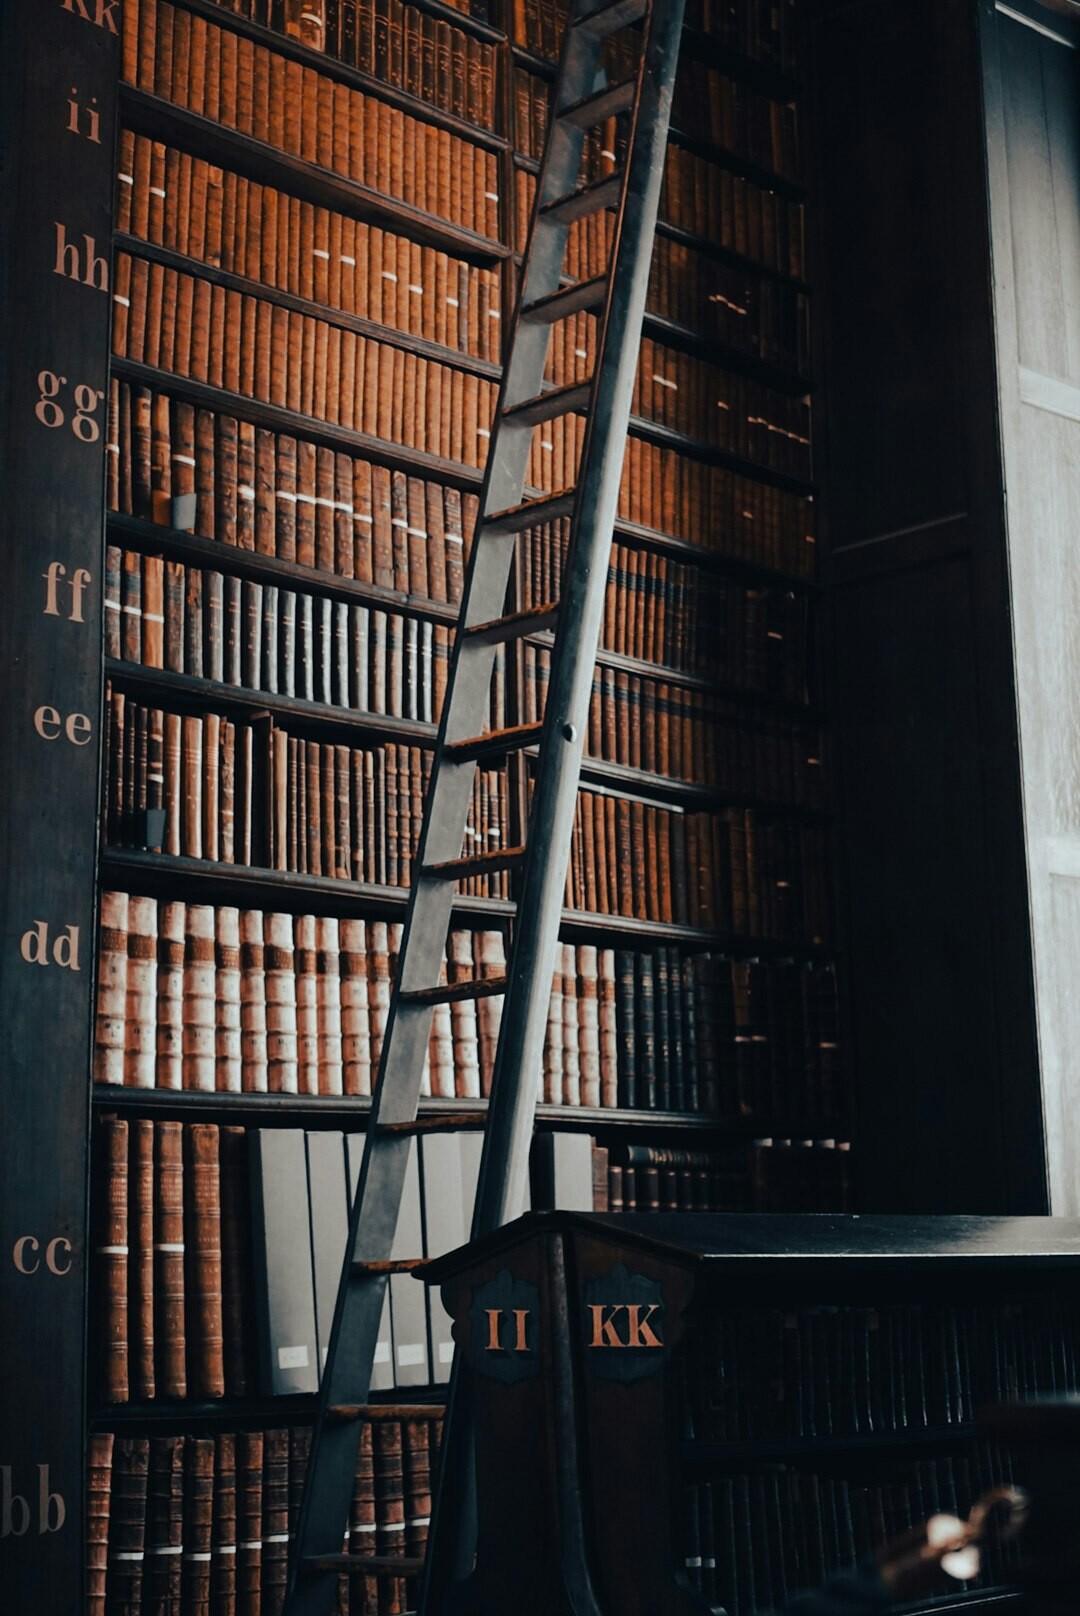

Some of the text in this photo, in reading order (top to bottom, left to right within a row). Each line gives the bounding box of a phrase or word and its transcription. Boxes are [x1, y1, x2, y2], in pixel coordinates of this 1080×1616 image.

[67, 87, 101, 144] ii
[53, 222, 109, 292] hh
[35, 370, 104, 442] gg
[42, 561, 91, 622] ff
[34, 705, 91, 745] ee
[20, 920, 80, 971] dd
[13, 1235, 72, 1275] cc
[485, 1309, 530, 1351] II
[587, 1304, 664, 1347] KK
[0, 1464, 66, 1538] bb
